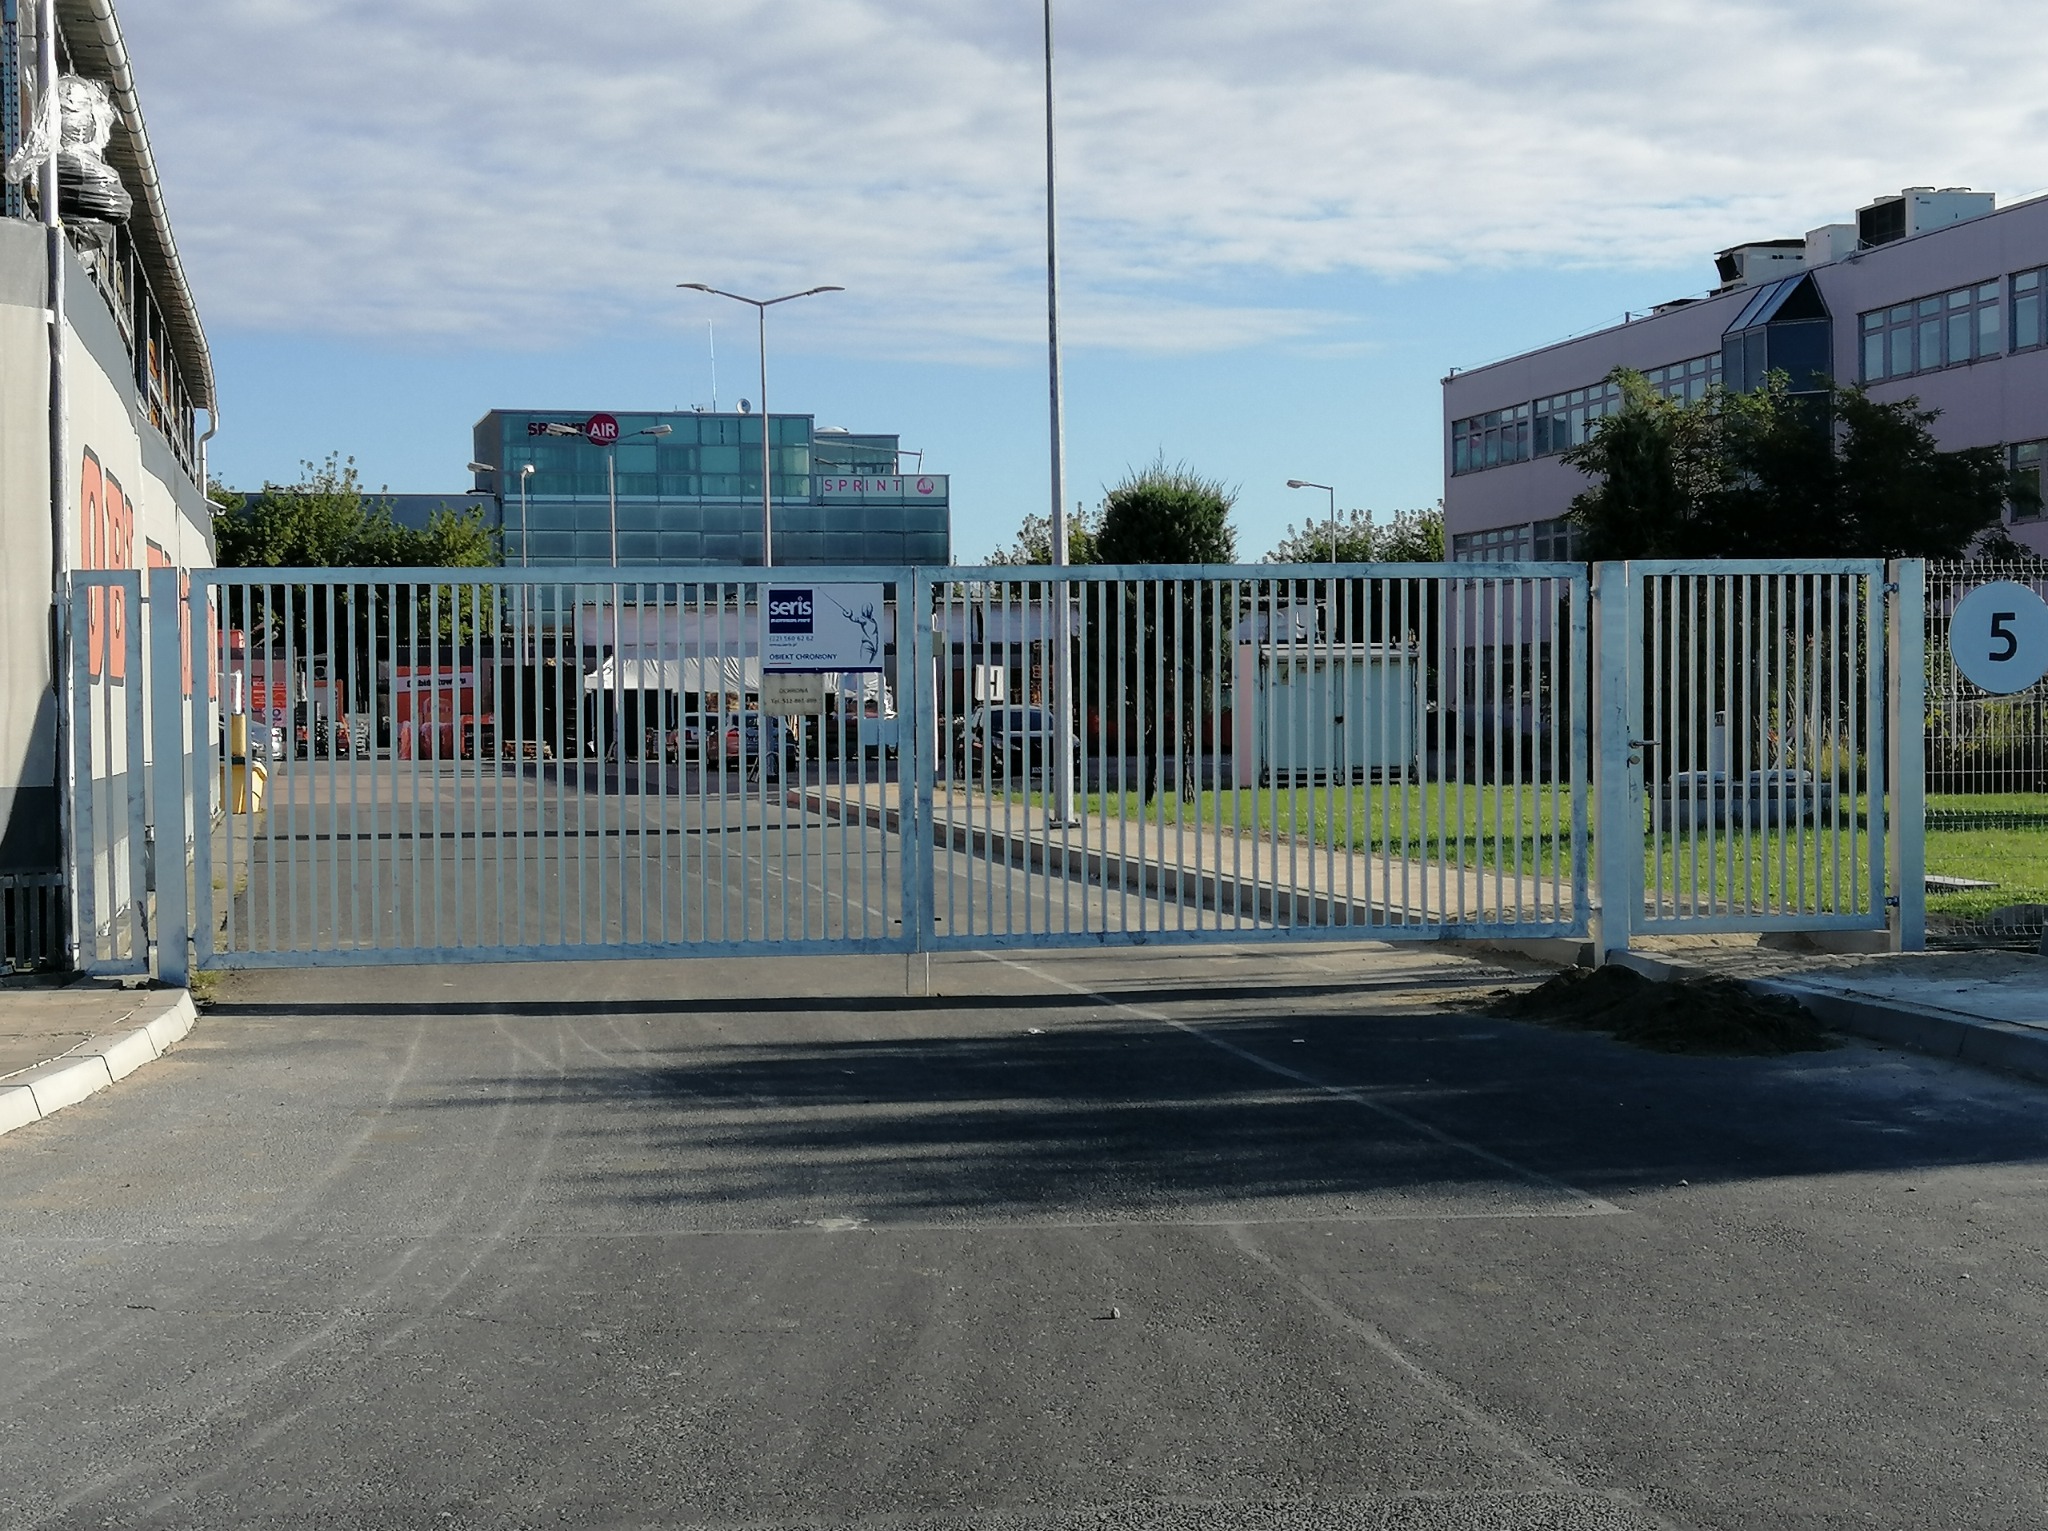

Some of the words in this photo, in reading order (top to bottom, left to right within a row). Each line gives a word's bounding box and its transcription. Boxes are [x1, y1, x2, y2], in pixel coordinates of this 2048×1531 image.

[590, 422, 616, 437] AIR
[824, 479, 901, 492] SPRINT
[770, 595, 812, 615] seris
[1988, 612, 2018, 662] 5
